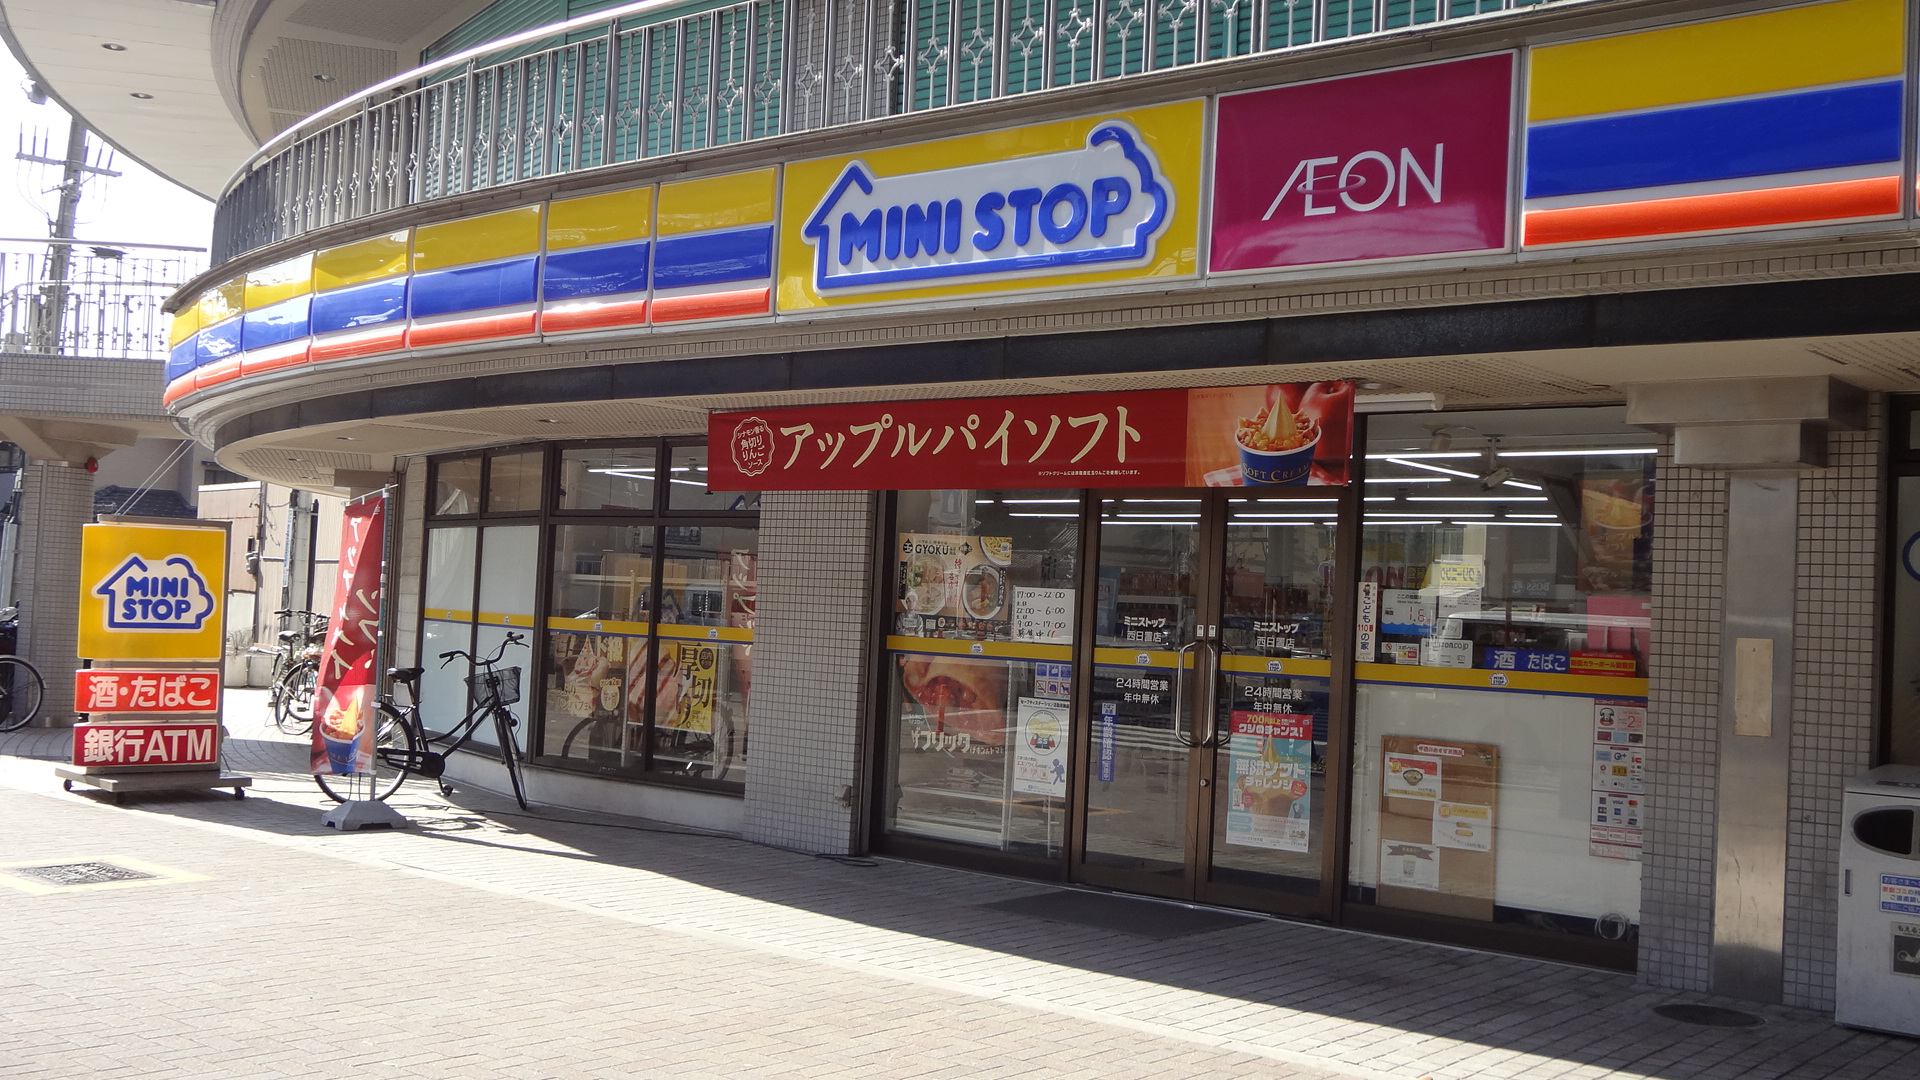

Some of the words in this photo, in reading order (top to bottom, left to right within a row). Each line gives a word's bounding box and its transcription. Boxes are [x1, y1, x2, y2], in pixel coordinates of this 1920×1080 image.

[838, 196, 962, 266] MINI
[972, 176, 1132, 252] STOP
[736, 425, 765, 439] シナモン香る
[779, 406, 1142, 470] アップルパイソフト
[739, 434, 763, 451] 角切り
[741, 446, 765, 462] りんご
[747, 459, 764, 469] ソース
[1242, 462, 1266, 479] SOFT
[915, 544, 949, 556] GYOKU
[126, 576, 188, 598] MINI
[1016, 591, 1035, 599] 17:00
[122, 598, 191, 621] STOP
[1016, 607, 1034, 615] 22:00
[1045, 606, 1066, 615] 6:00
[1017, 620, 1033, 628] 9:00
[1043, 620, 1067, 629] 17:00
[1123, 615, 1167, 628] ミニストップ
[1253, 620, 1300, 634] ミニストップ
[1126, 630, 1162, 643] 西日置店
[1256, 636, 1295, 649] 西日置店
[1493, 650, 1517, 669] 酒
[1527, 652, 1566, 671] たばこ
[1116, 677, 1169, 691] 24時間営業
[87, 675, 212, 709] 酒・たばこ
[1123, 692, 1160, 705] 年中無休
[1244, 685, 1303, 701] 24時間営業
[1253, 701, 1293, 714] 年中無休
[1102, 715, 1114, 761] 年齢確認
[1238, 723, 1305, 738] クジのチャンス!
[83, 728, 213, 764] 銀行ATM
[1236, 758, 1307, 779] 無限ソフト
[1245, 776, 1293, 791] チャレンジ
